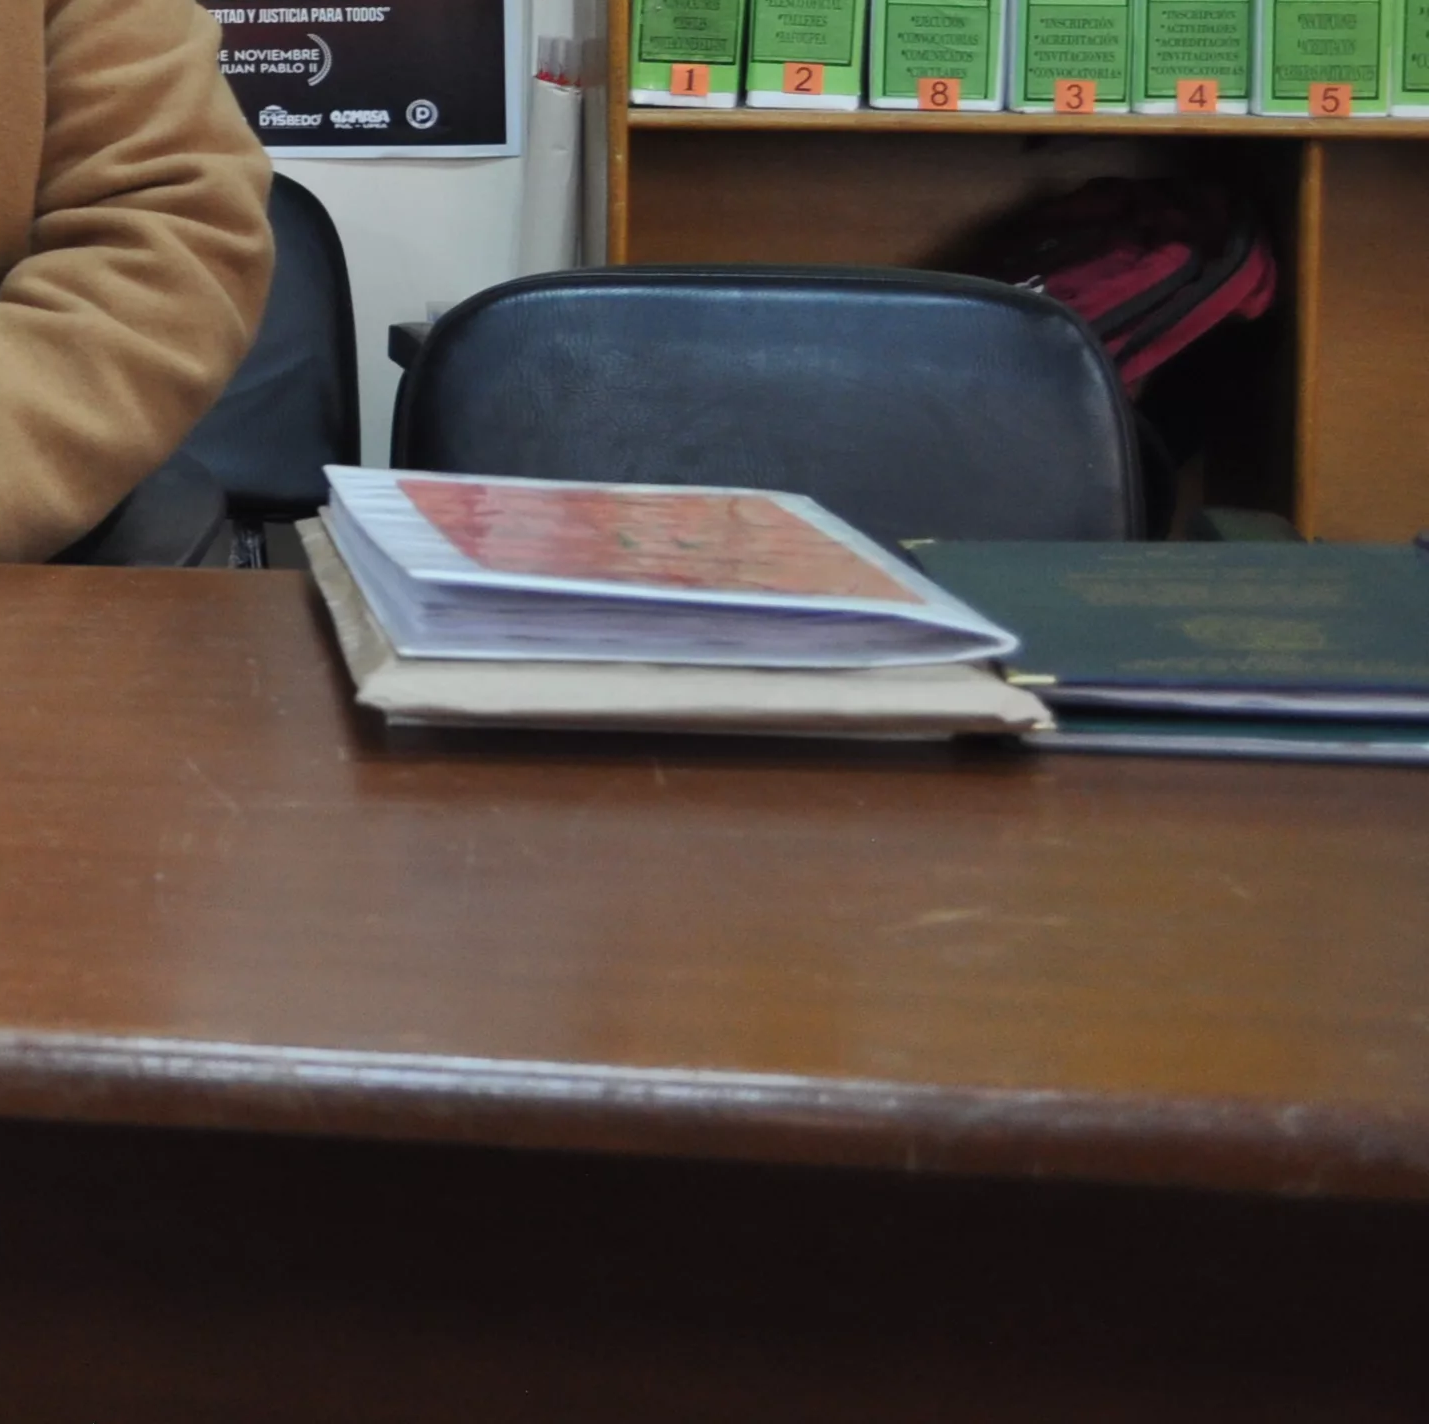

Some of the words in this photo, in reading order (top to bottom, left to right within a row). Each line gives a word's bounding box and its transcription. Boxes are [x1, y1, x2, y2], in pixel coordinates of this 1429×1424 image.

[246, 9, 255, 22] Y
[257, 8, 308, 23] JUSTICIA
[311, 7, 342, 23] PARA
[234, 48, 320, 62] NOVIEMBRE
[221, 63, 255, 74] JUAN
[260, 63, 304, 74] PABLO
[684, 68, 694, 91] 1
[794, 67, 813, 92] 2
[930, 81, 949, 107] 8
[1065, 84, 1083, 109] 3
[1188, 85, 1207, 107] 4
[1321, 88, 1340, 112] 5
